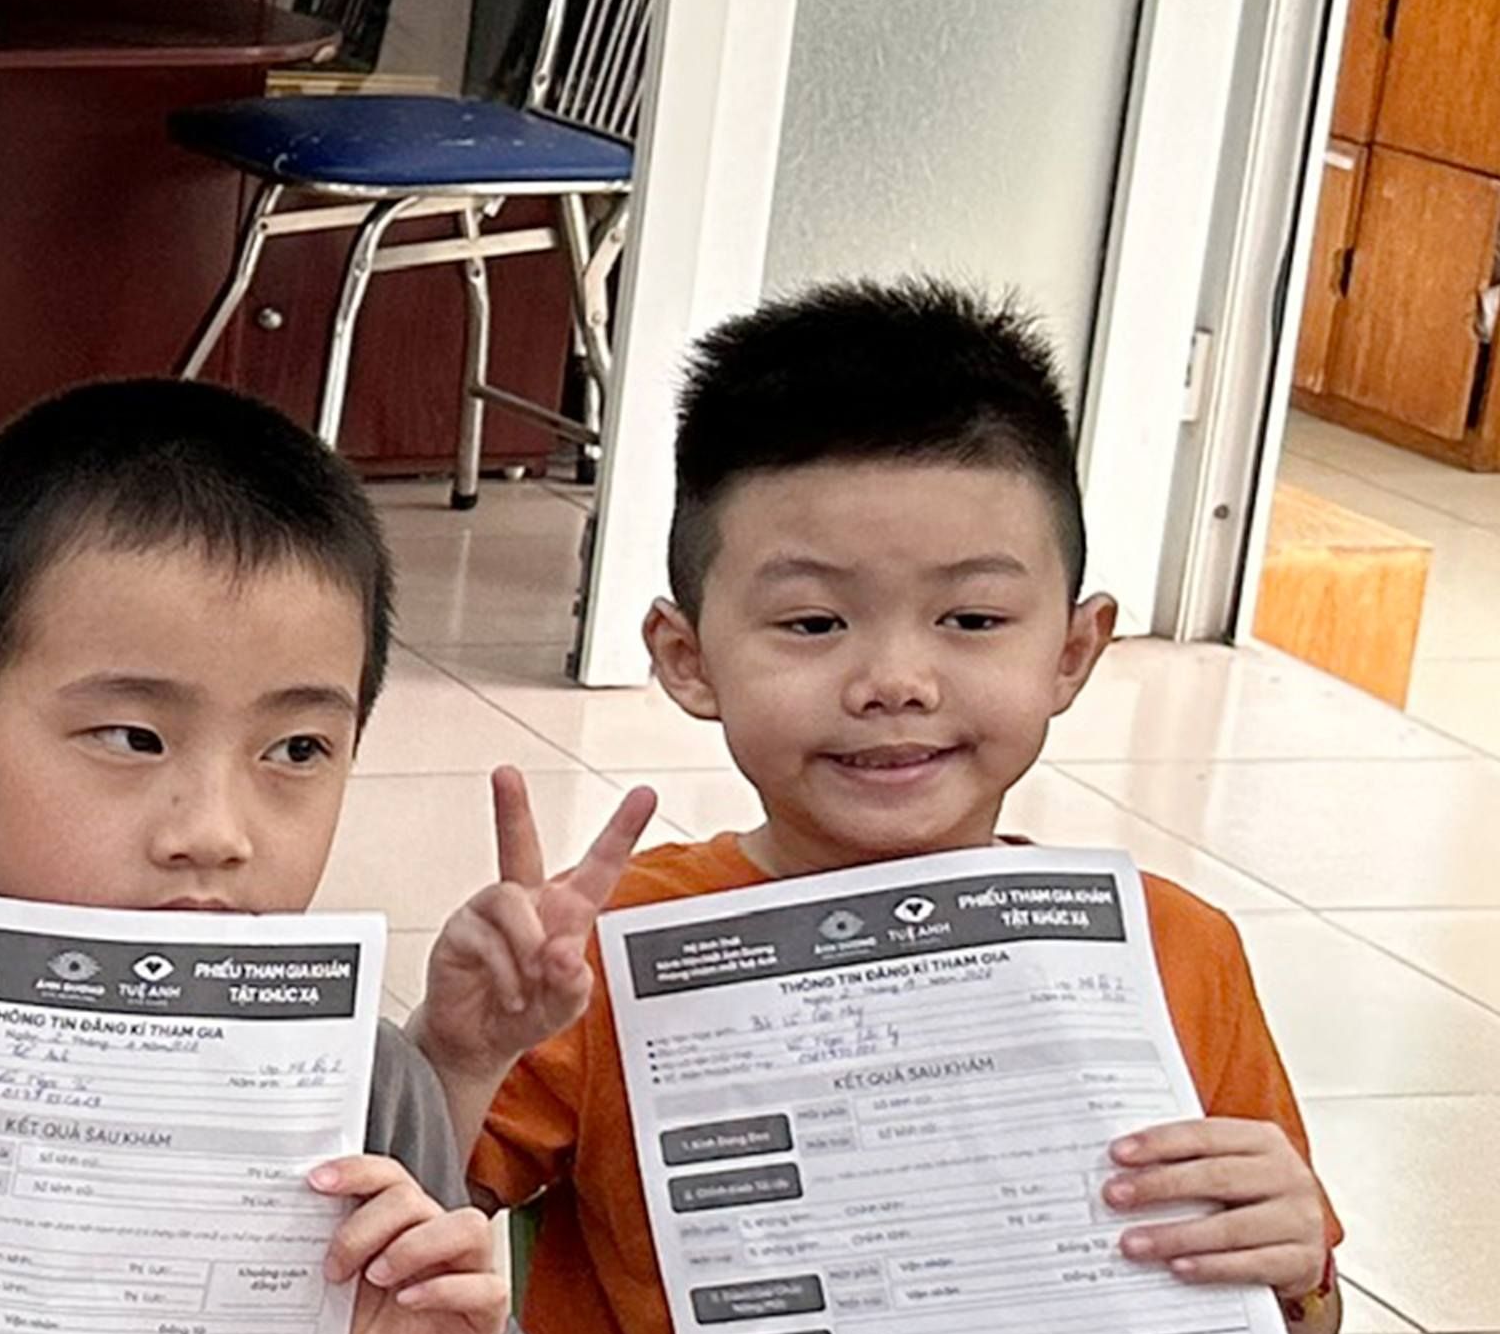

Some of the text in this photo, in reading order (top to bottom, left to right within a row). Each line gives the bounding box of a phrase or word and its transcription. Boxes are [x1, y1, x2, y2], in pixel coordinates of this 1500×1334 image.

[779, 973, 835, 994] THÔNG
[837, 971, 864, 985] TIN
[930, 953, 977, 971] THAM
[149, 984, 181, 999] ANH
[49, 1013, 78, 1029] TIN
[150, 1021, 195, 1038] THAM
[197, 1024, 225, 1040] GIA
